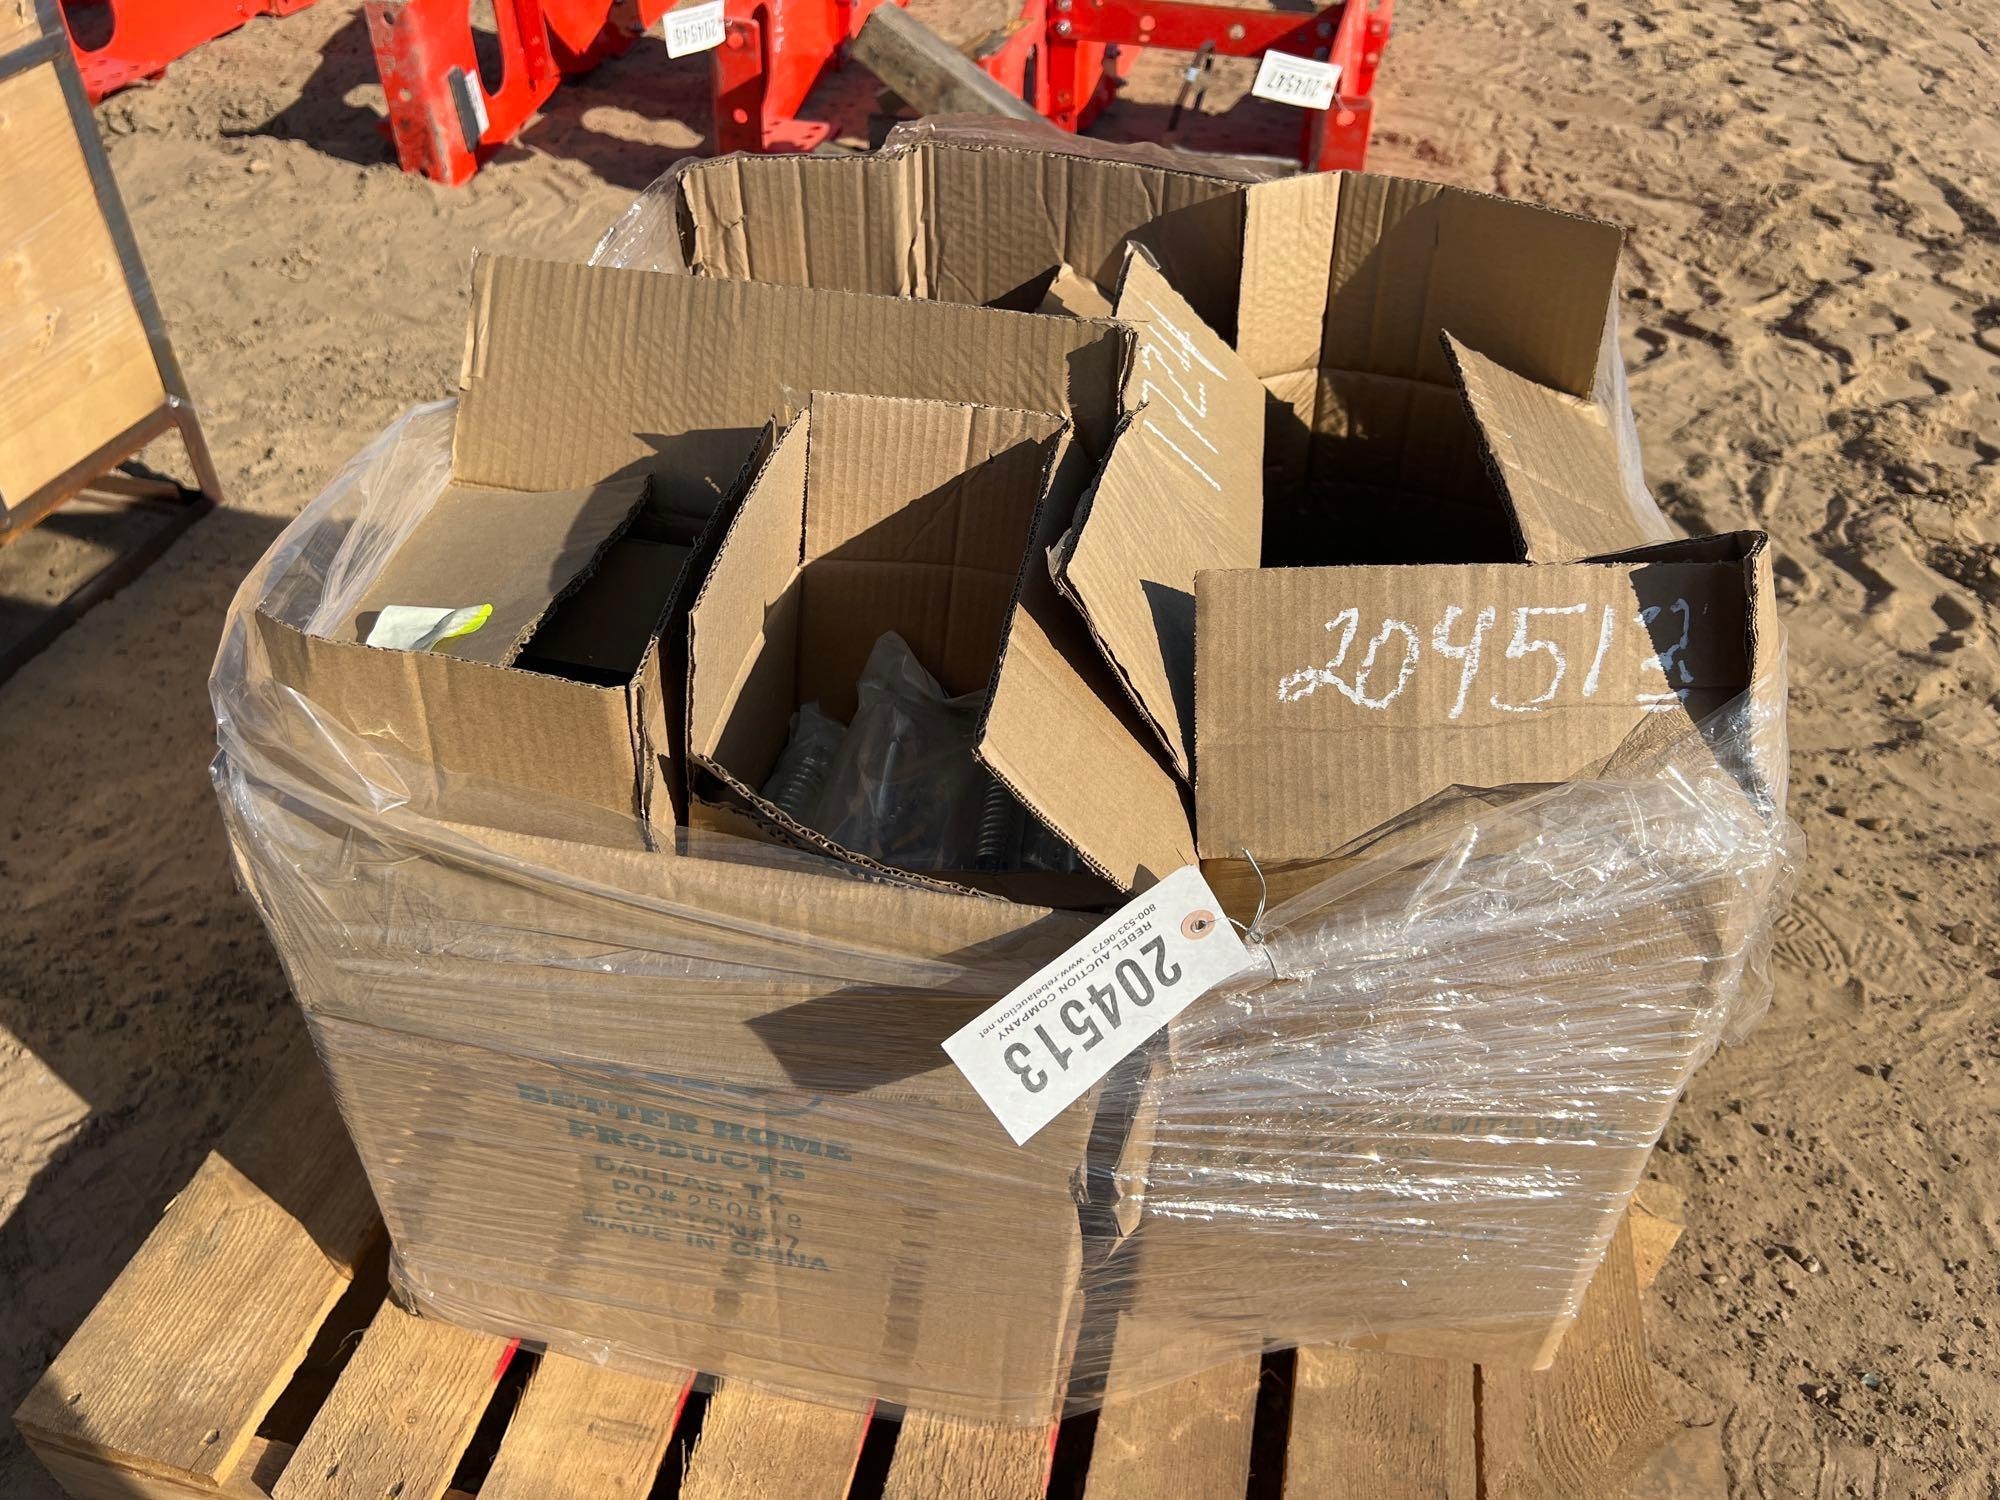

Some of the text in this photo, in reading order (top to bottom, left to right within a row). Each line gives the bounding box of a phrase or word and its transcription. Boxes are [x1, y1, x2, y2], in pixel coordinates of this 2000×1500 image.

[979, 903, 1157, 1039] 800-533-0673 www.rebelauction.net
[998, 920, 1153, 1041] REBEL AUCTION COMPANY
[1003, 934, 1182, 1094] 204513
[516, 1082, 852, 1162] BETTER HOME
[567, 1118, 806, 1180] PRODUCTS
[582, 1207, 672, 1243] MADE
[686, 1231, 717, 1251] IN
[612, 1178, 678, 1203] PO#
